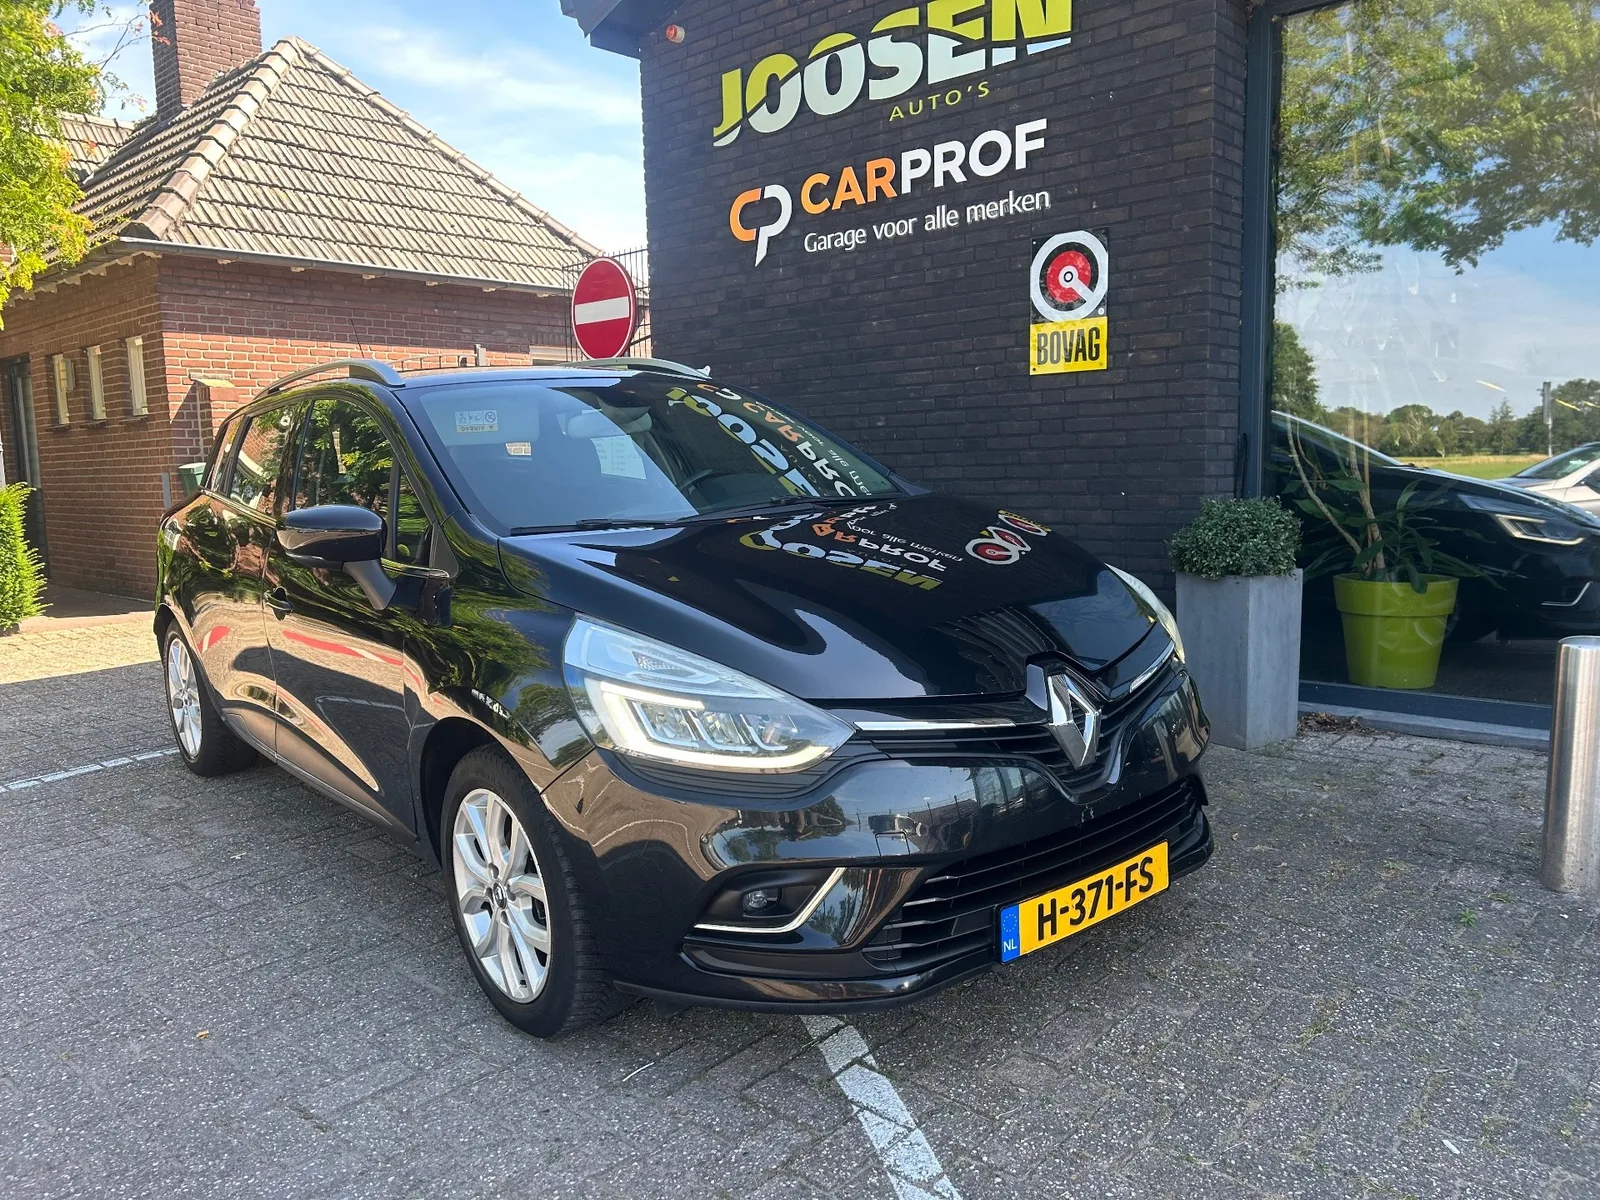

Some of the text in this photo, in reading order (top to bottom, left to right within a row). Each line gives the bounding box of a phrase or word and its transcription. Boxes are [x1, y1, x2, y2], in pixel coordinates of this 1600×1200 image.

[712, 0, 1073, 147] JOOSEN
[888, 81, 991, 122] AUTO'S
[801, 118, 1048, 215] CARPROF
[804, 189, 1051, 253] Garage voor alle merken
[1036, 326, 1101, 366] BOVAG
[1037, 856, 1154, 942] H-371-FS
[1003, 938, 1018, 953] NL
